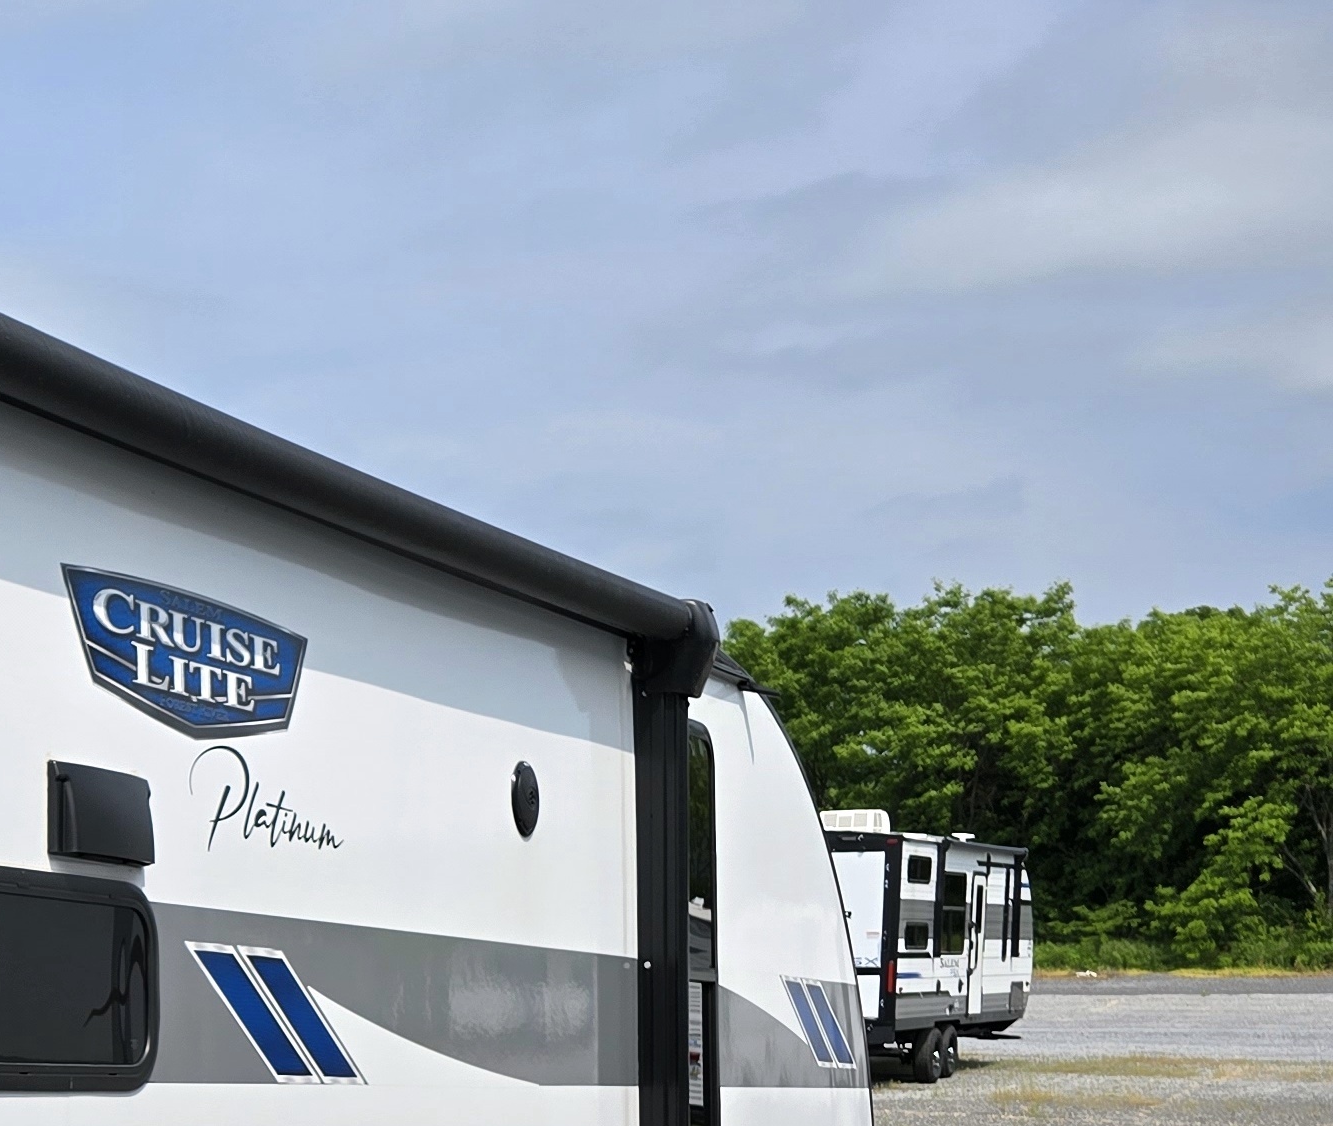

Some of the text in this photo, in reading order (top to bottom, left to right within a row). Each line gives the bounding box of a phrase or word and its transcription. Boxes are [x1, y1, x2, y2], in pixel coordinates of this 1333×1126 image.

[92, 587, 281, 677] CRUISE
[131, 640, 256, 712] LITE
[189, 745, 344, 852] Platinum
